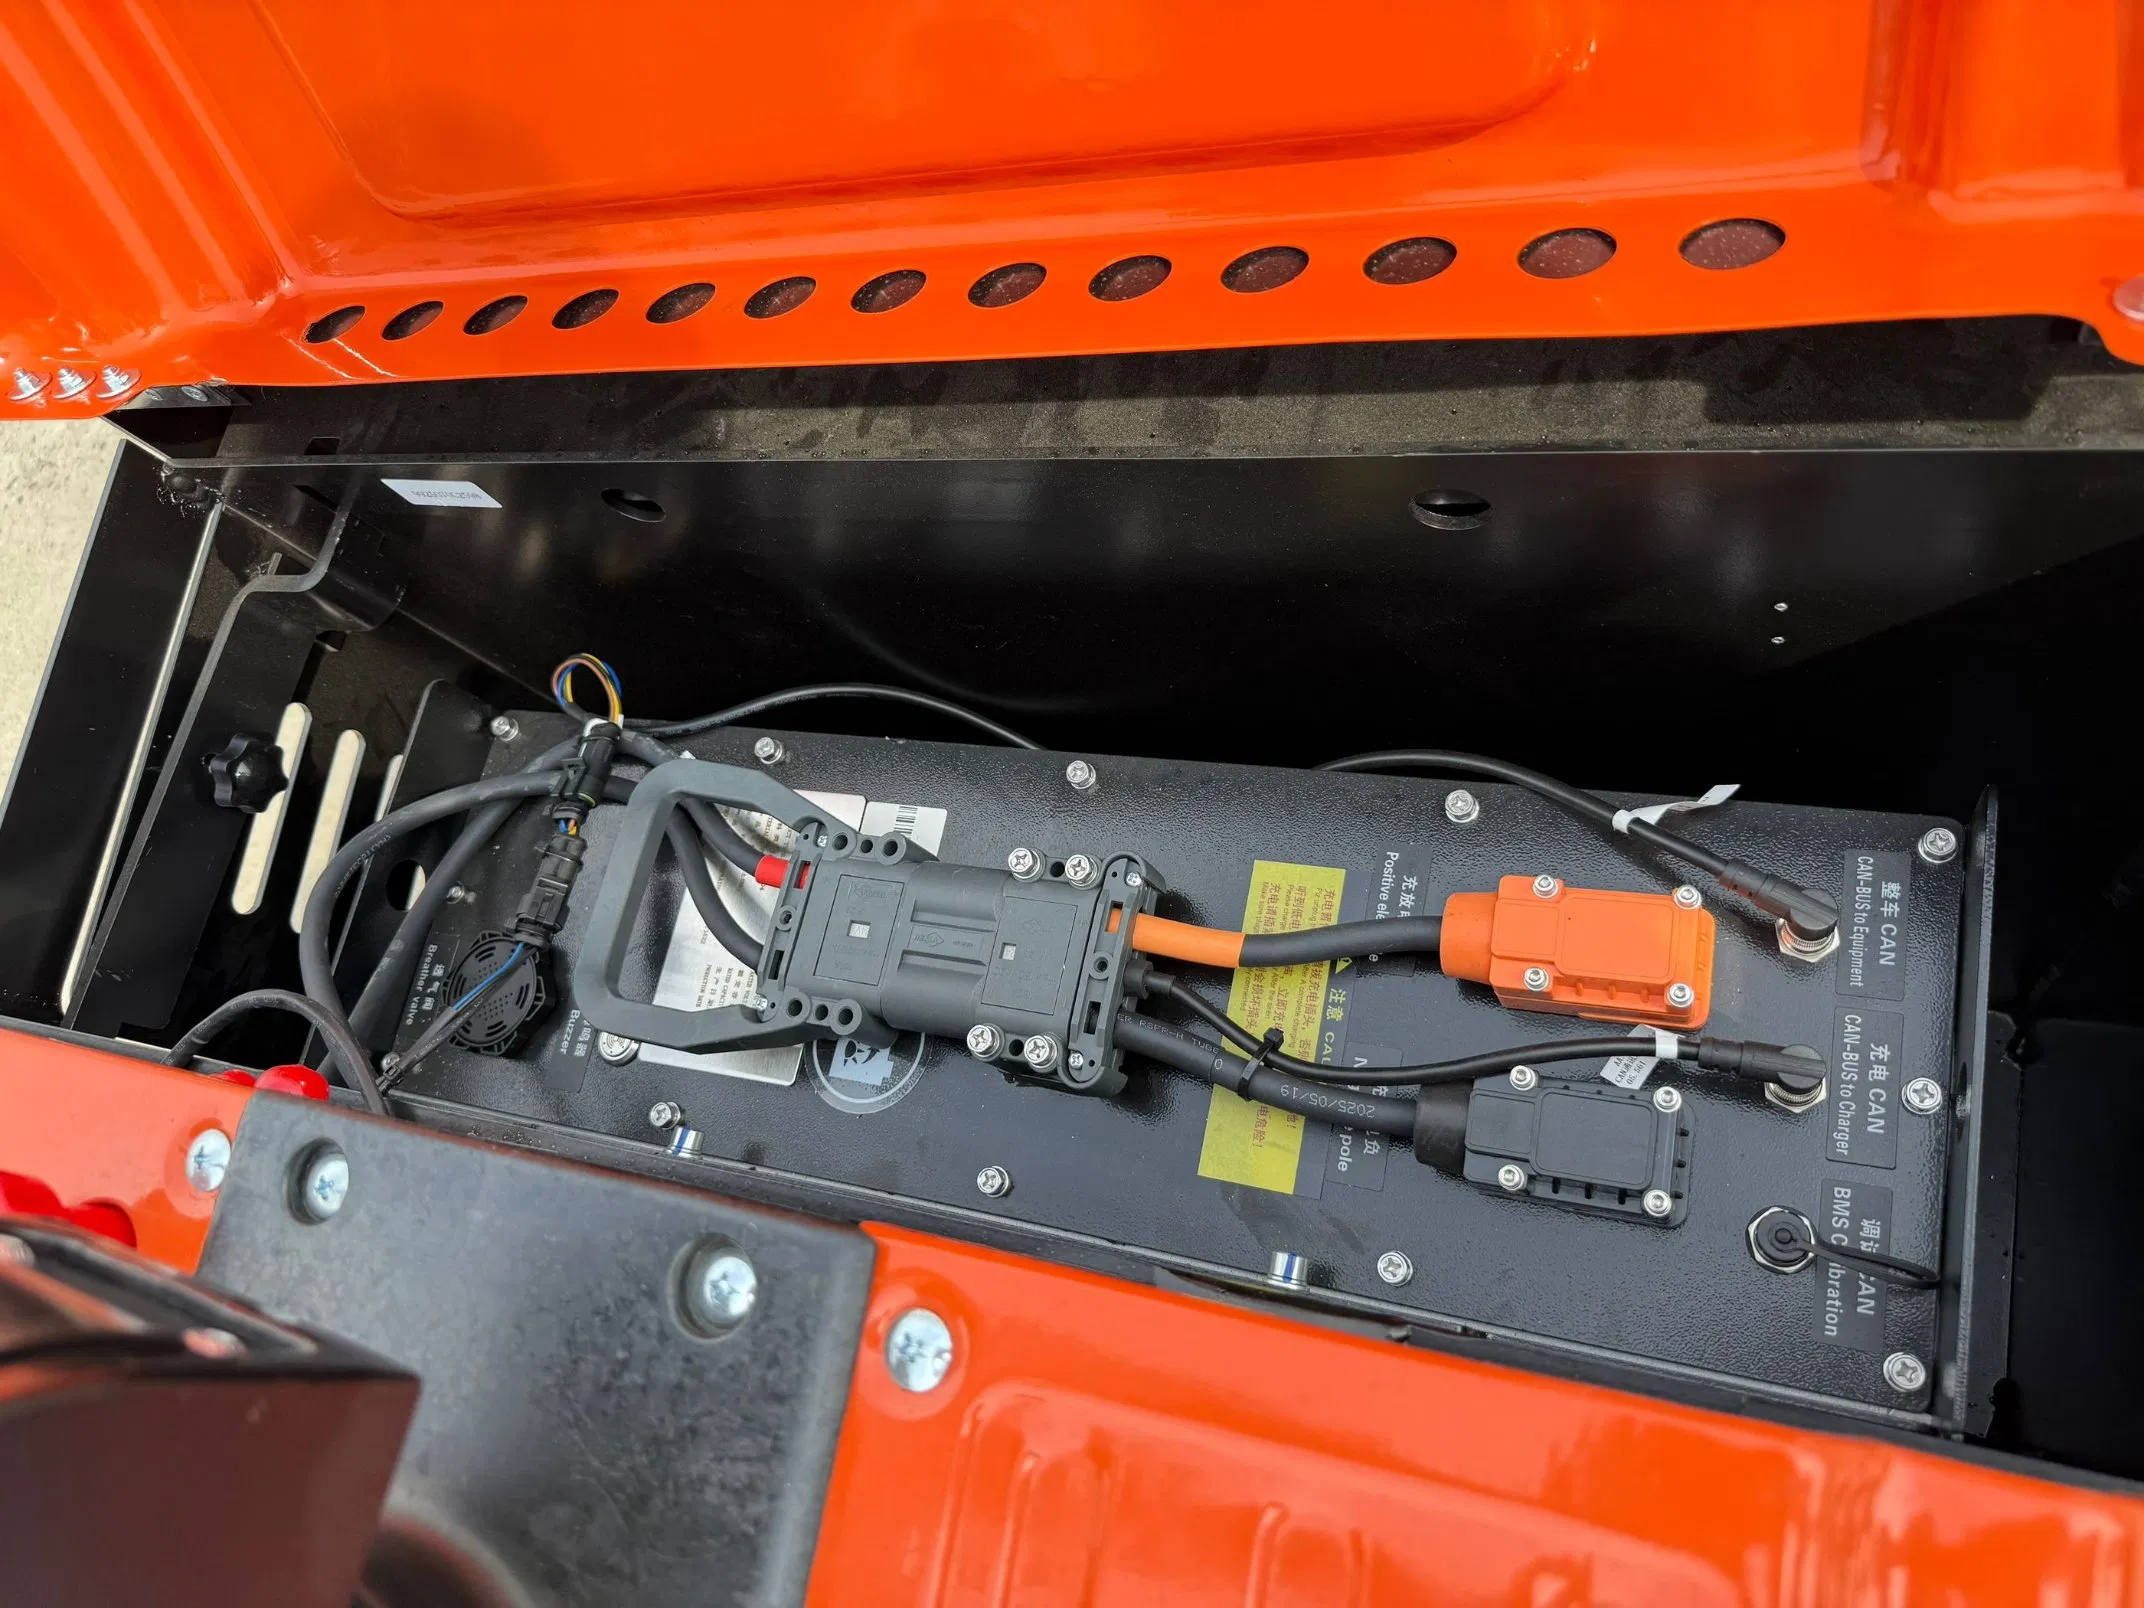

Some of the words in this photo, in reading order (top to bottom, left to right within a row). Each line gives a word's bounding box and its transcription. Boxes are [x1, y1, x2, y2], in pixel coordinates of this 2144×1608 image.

[1285, 884, 1294, 907] Please
[1378, 851, 1399, 900] Positive
[1854, 856, 1874, 914] CAN-BUS
[1853, 912, 1868, 924] to
[1880, 880, 1901, 917] 整车
[1848, 926, 1870, 988] Equipment
[1879, 923, 1898, 966] CAN
[415, 944, 438, 992] Breather
[405, 996, 420, 1026] valve
[1295, 986, 1305, 1017] complete
[1325, 988, 1347, 1022] 注意
[560, 1009, 581, 1055] Buzzer
[1288, 1019, 1299, 1049] charging
[1841, 1014, 1862, 1081] CAN-BUS
[1868, 1043, 1891, 1082] 充电
[1280, 1083, 1376, 1119] 2025/05/19
[1839, 1084, 1856, 1098] to
[1866, 1088, 1887, 1134] CAN
[1832, 1100, 1856, 1156] Charger
[1831, 1186, 1851, 1229] BMS
[1823, 1233, 1849, 1336] Cibration
